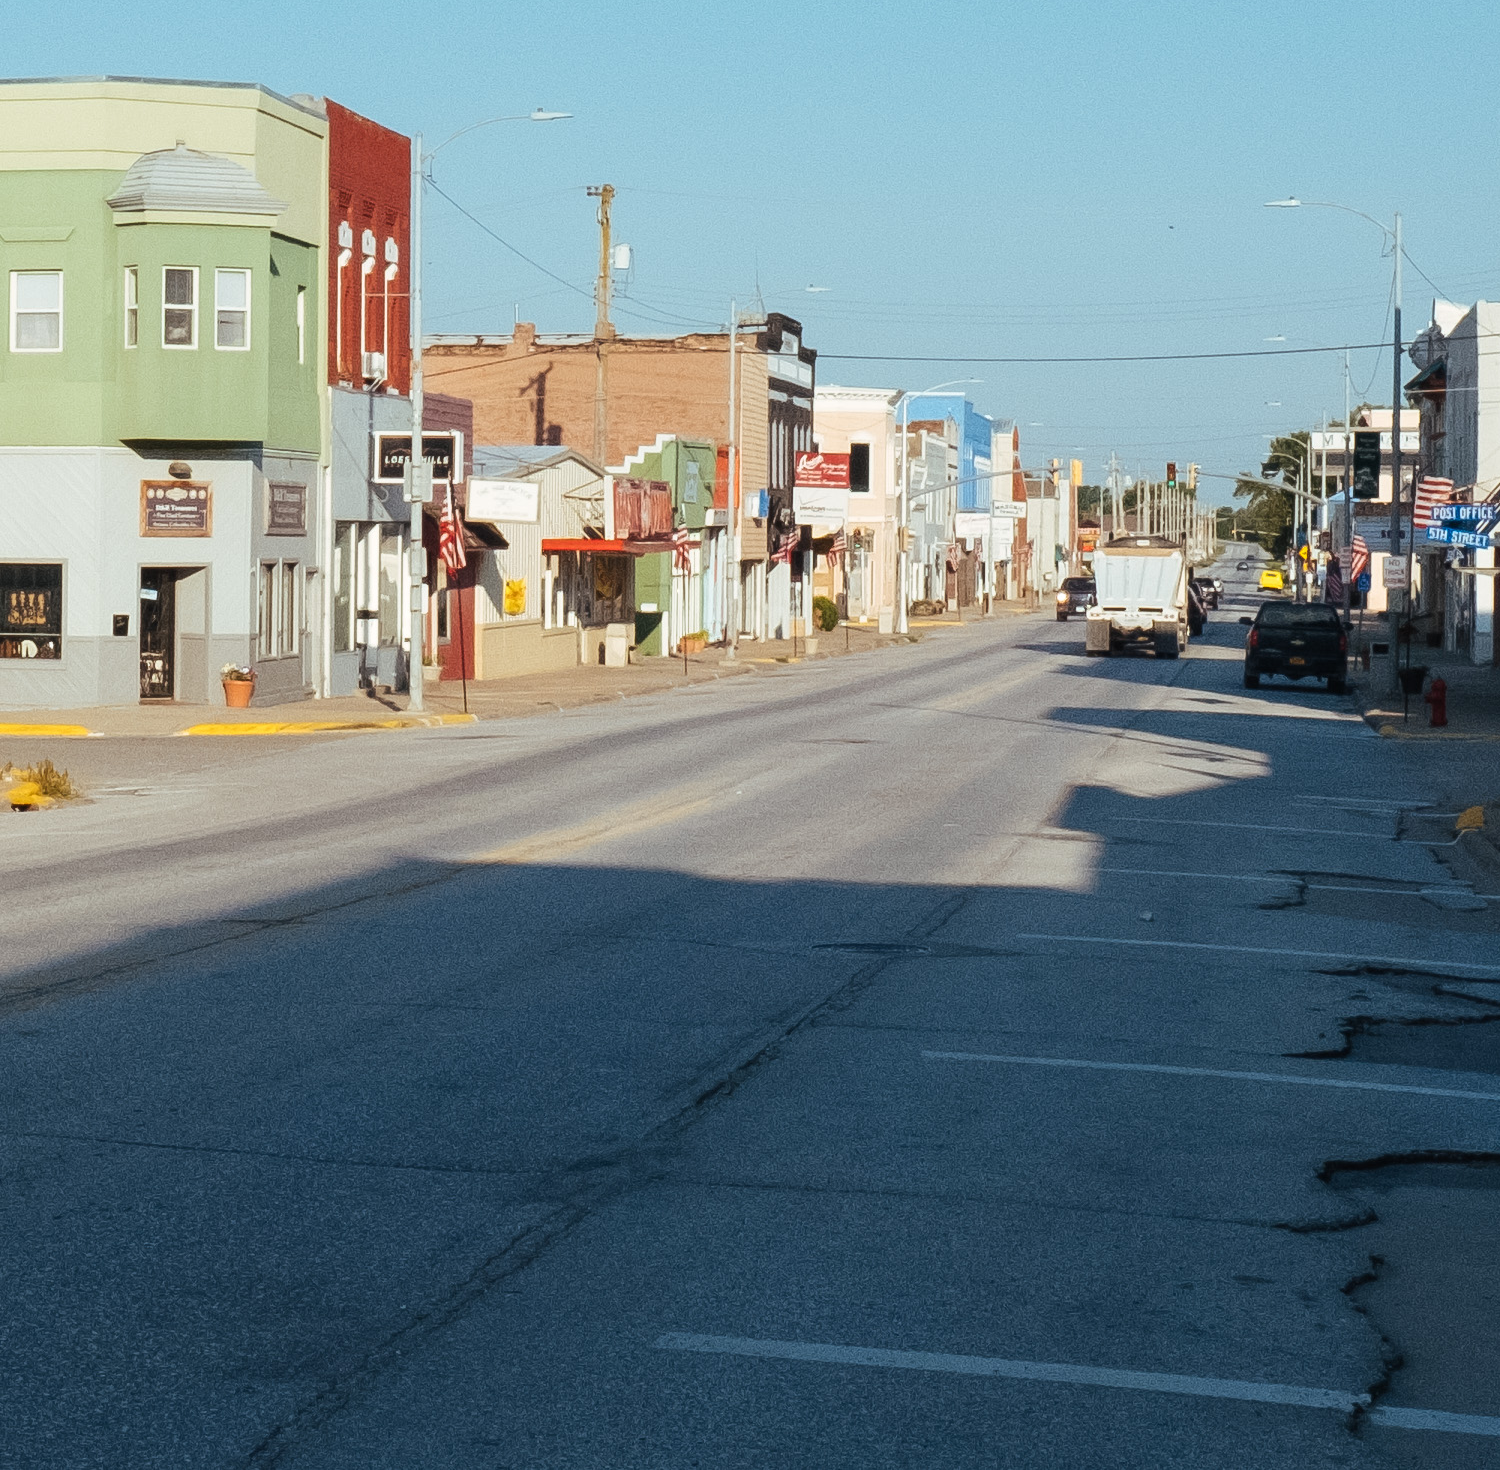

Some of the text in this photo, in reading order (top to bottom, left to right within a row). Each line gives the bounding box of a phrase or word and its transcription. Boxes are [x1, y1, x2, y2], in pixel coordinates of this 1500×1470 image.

[1433, 507, 1494, 520] POST OFFICE
[1428, 528, 1488, 547] 5TH STREET
